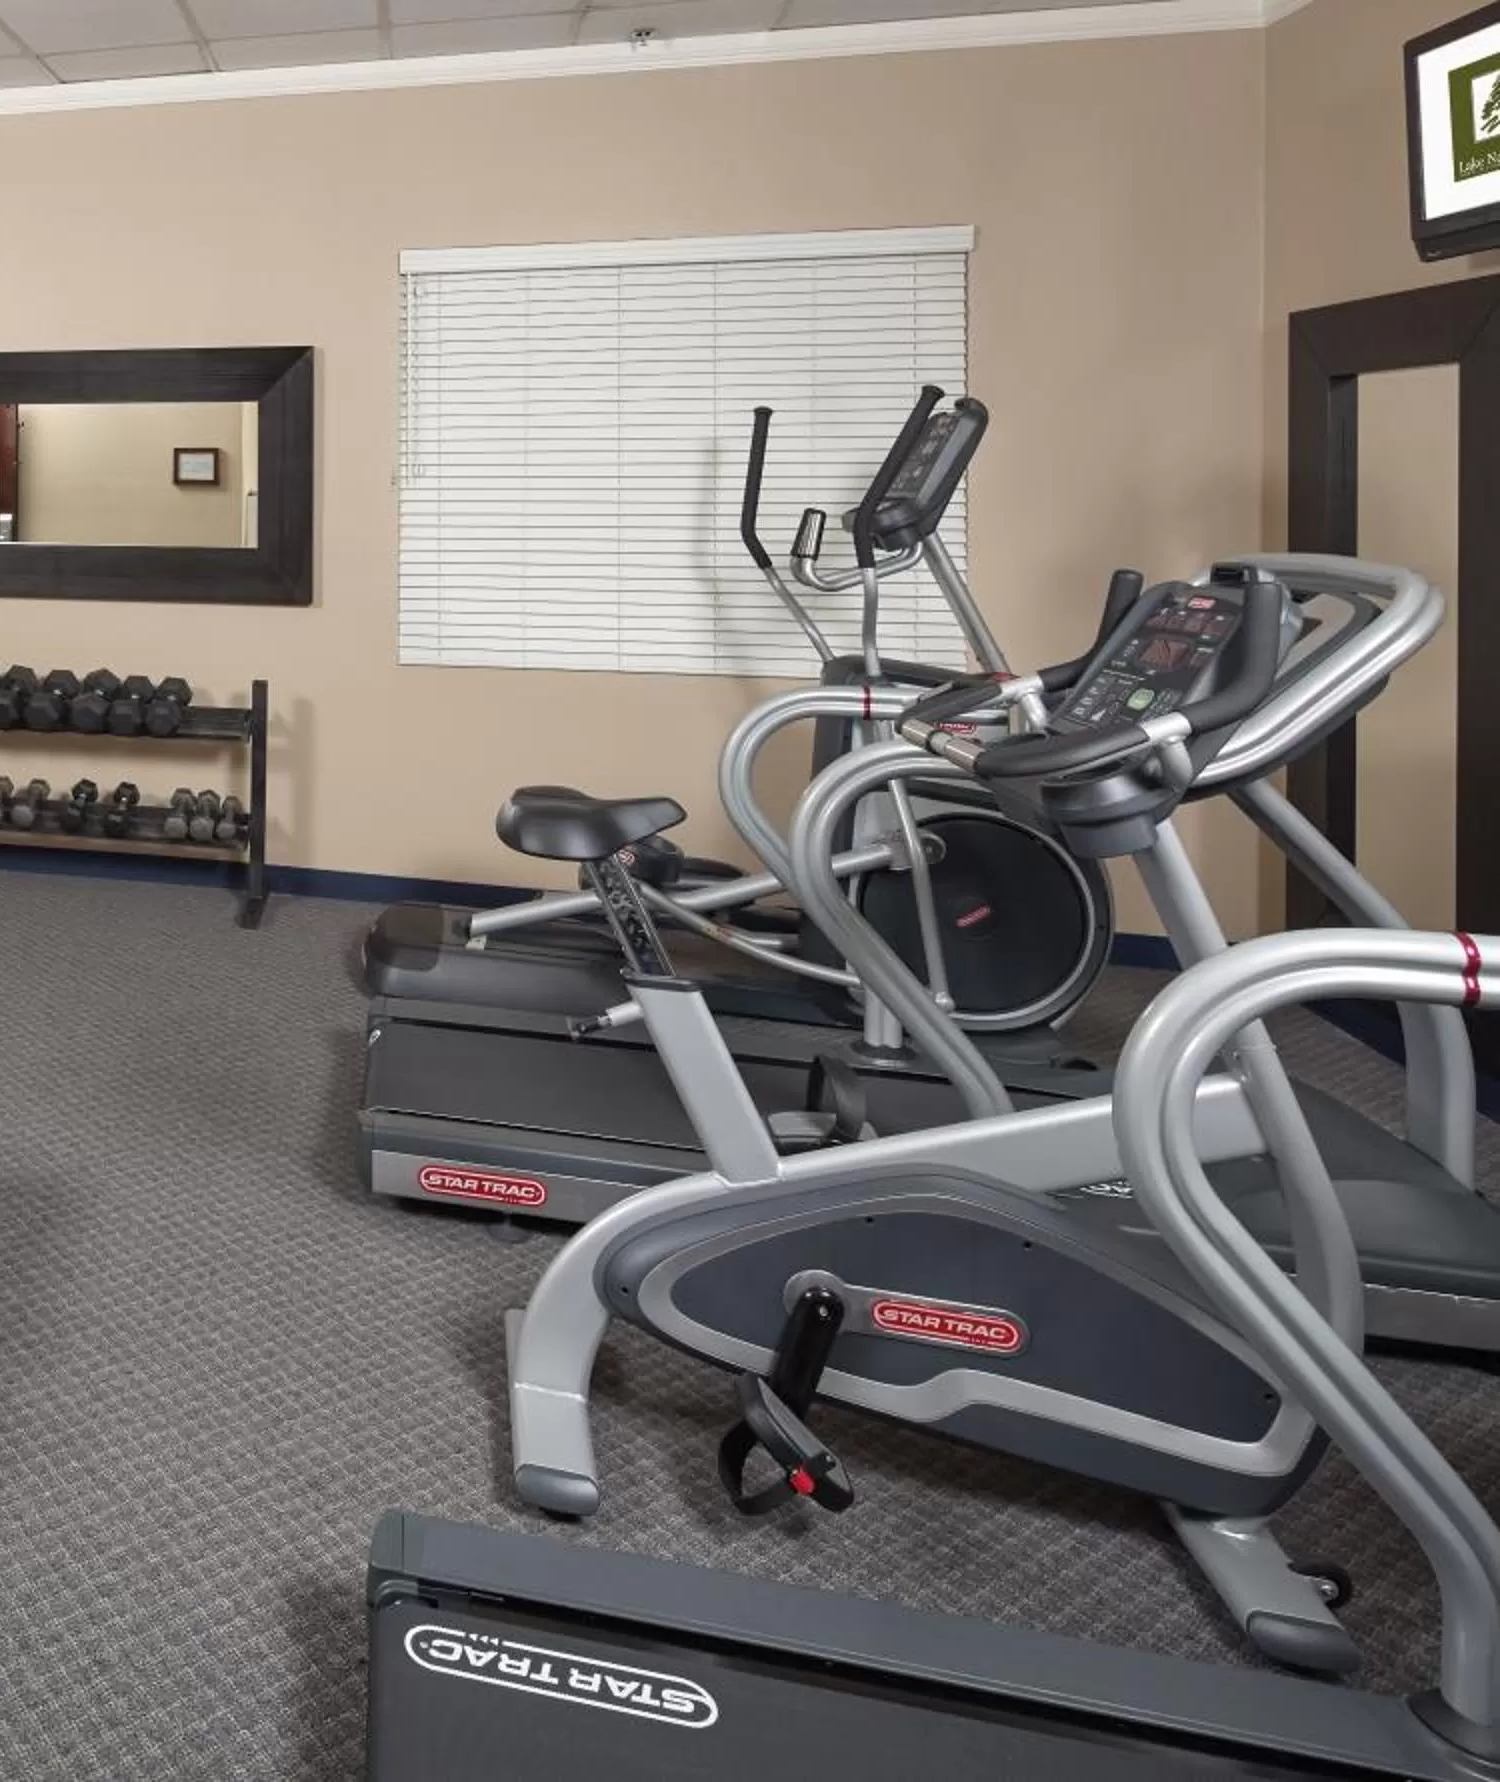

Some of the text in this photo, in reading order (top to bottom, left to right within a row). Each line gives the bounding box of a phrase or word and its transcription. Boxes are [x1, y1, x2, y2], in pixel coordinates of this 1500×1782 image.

[424, 1174, 537, 1199] STAR TRAC
[879, 1309, 1008, 1339] STAR TRAC
[428, 1639, 700, 1714] STAR TRAC
